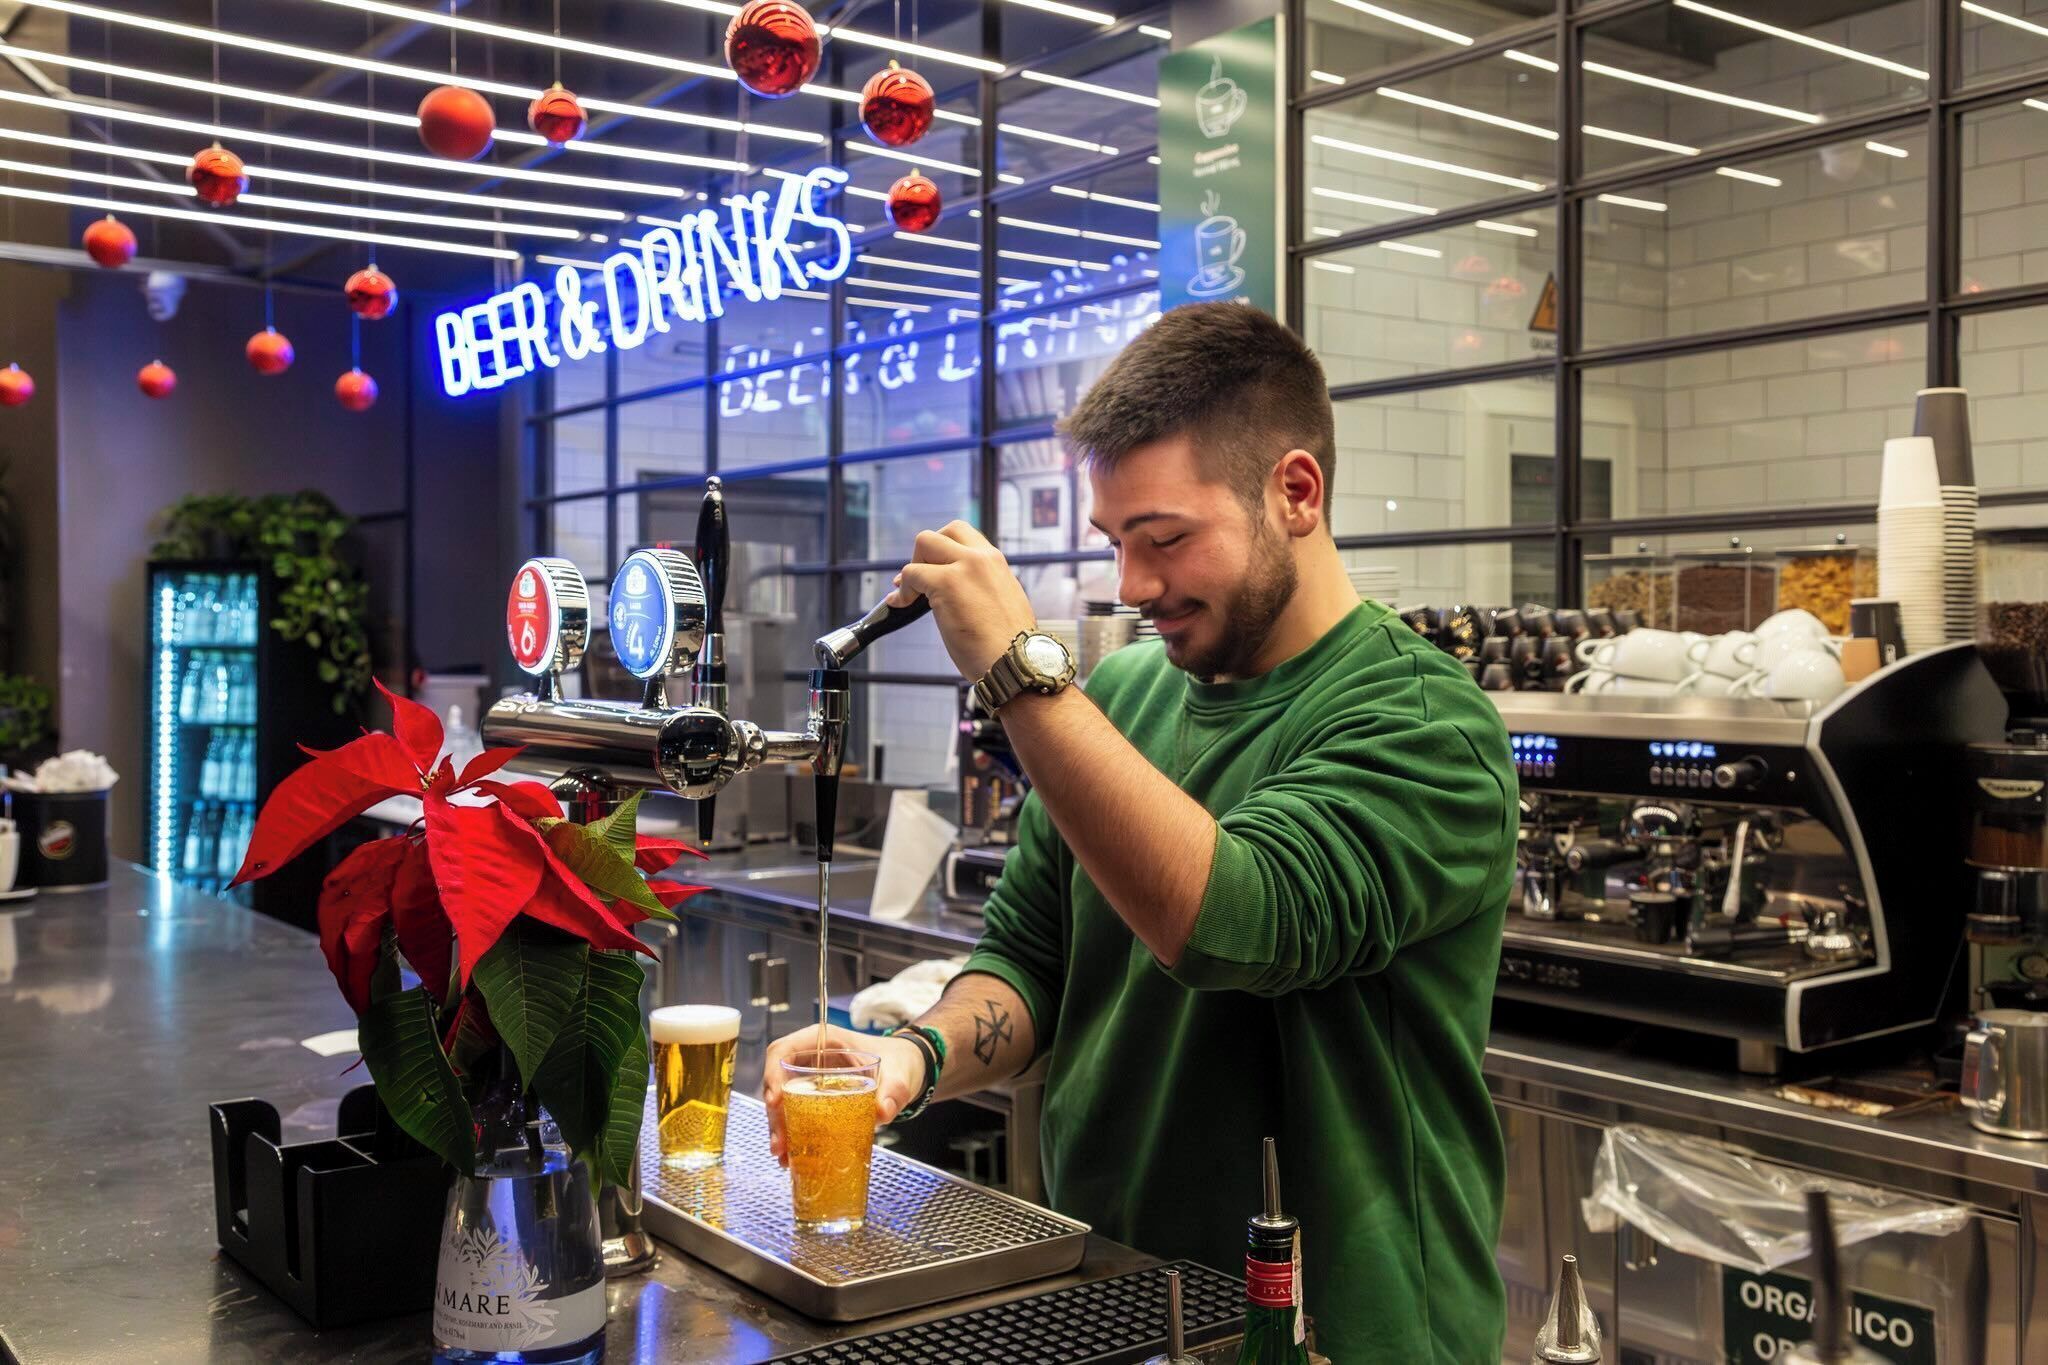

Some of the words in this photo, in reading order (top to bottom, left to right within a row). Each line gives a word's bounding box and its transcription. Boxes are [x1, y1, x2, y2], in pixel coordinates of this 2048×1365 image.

[436, 281, 560, 396] BEER
[555, 265, 607, 361] &
[603, 166, 852, 350] DRINKS
[629, 622, 645, 660] 4
[443, 1287, 511, 1316] MARE
[1739, 1280, 1915, 1347] ORGICO
